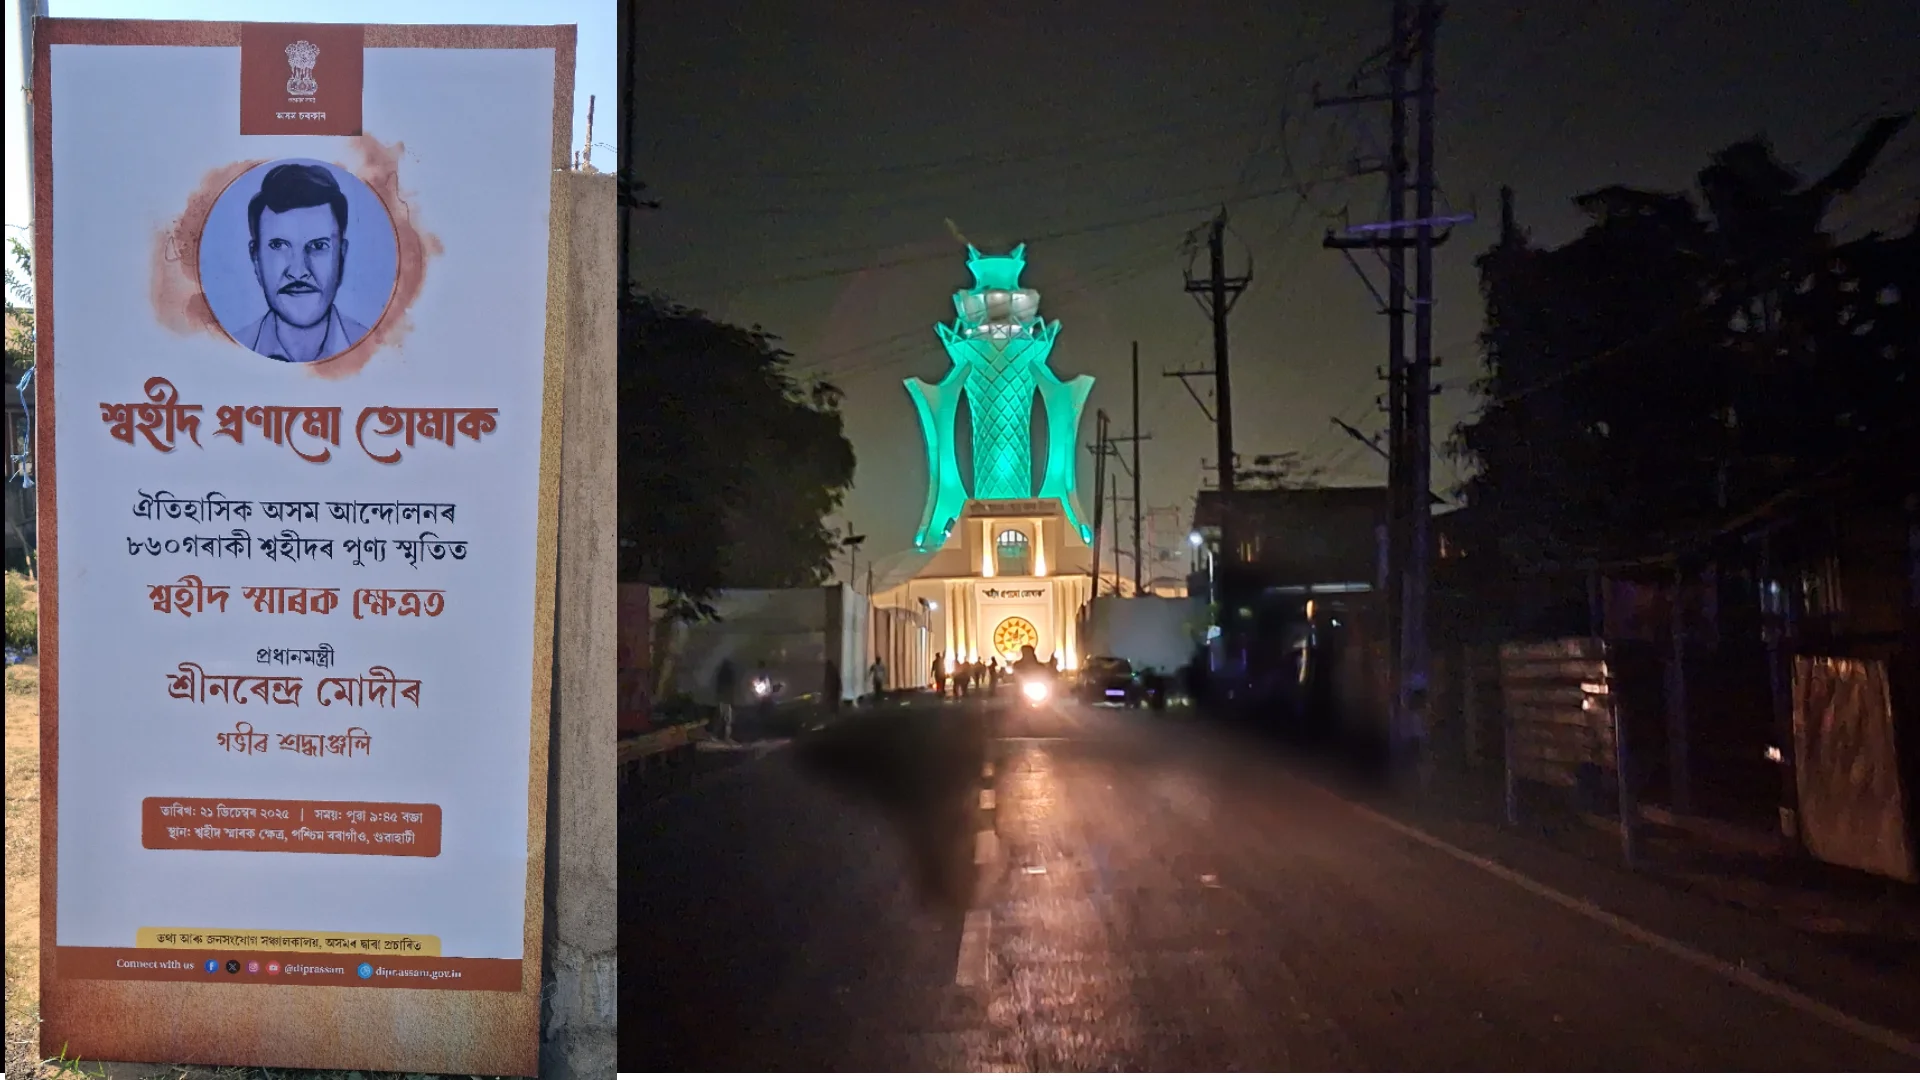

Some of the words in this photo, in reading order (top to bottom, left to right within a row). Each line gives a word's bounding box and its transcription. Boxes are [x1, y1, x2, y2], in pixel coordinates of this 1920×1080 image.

[100, 376, 203, 453] শ্বহীদ
[213, 404, 343, 463] প্ৰণামো
[356, 405, 499, 465] তোমাক
[133, 488, 253, 522] ঐতিহাসিক
[259, 500, 320, 523] অসম
[326, 499, 456, 525] আন্দোলনৰ
[258, 530, 334, 562] শ্বহীদৰ
[343, 539, 387, 567] পুণ্য
[393, 533, 469, 569] স্মৃতিত
[147, 574, 231, 618] শ্বহীদ
[241, 585, 341, 617] স্মাৰক
[353, 588, 447, 620] ক্ষেত্ৰত
[256, 643, 335, 668] প্ৰধানমন্ত্ৰী
[318, 665, 423, 709] মোদীৰ
[217, 722, 269, 755] গভীৰ
[276, 727, 373, 758] শ্ৰদ্ধাঞ্জলি
[200, 807, 214, 818] ২১
[260, 808, 290, 819] ২০২৫
[370, 812, 398, 823] ৯:৪৫
[401, 811, 423, 824] বজা
[157, 933, 176, 945] তথ্য
[206, 934, 258, 946] জনসংযোগ
[325, 938, 357, 949] অসমৰ
[384, 938, 421, 951] প্ৰচাৰিত
[116, 958, 157, 969] Connect
[159, 959, 180, 969] with
[183, 962, 195, 970] us
[284, 963, 344, 976] @diprassam
[376, 965, 462, 980] dipr.assam.gov.in
